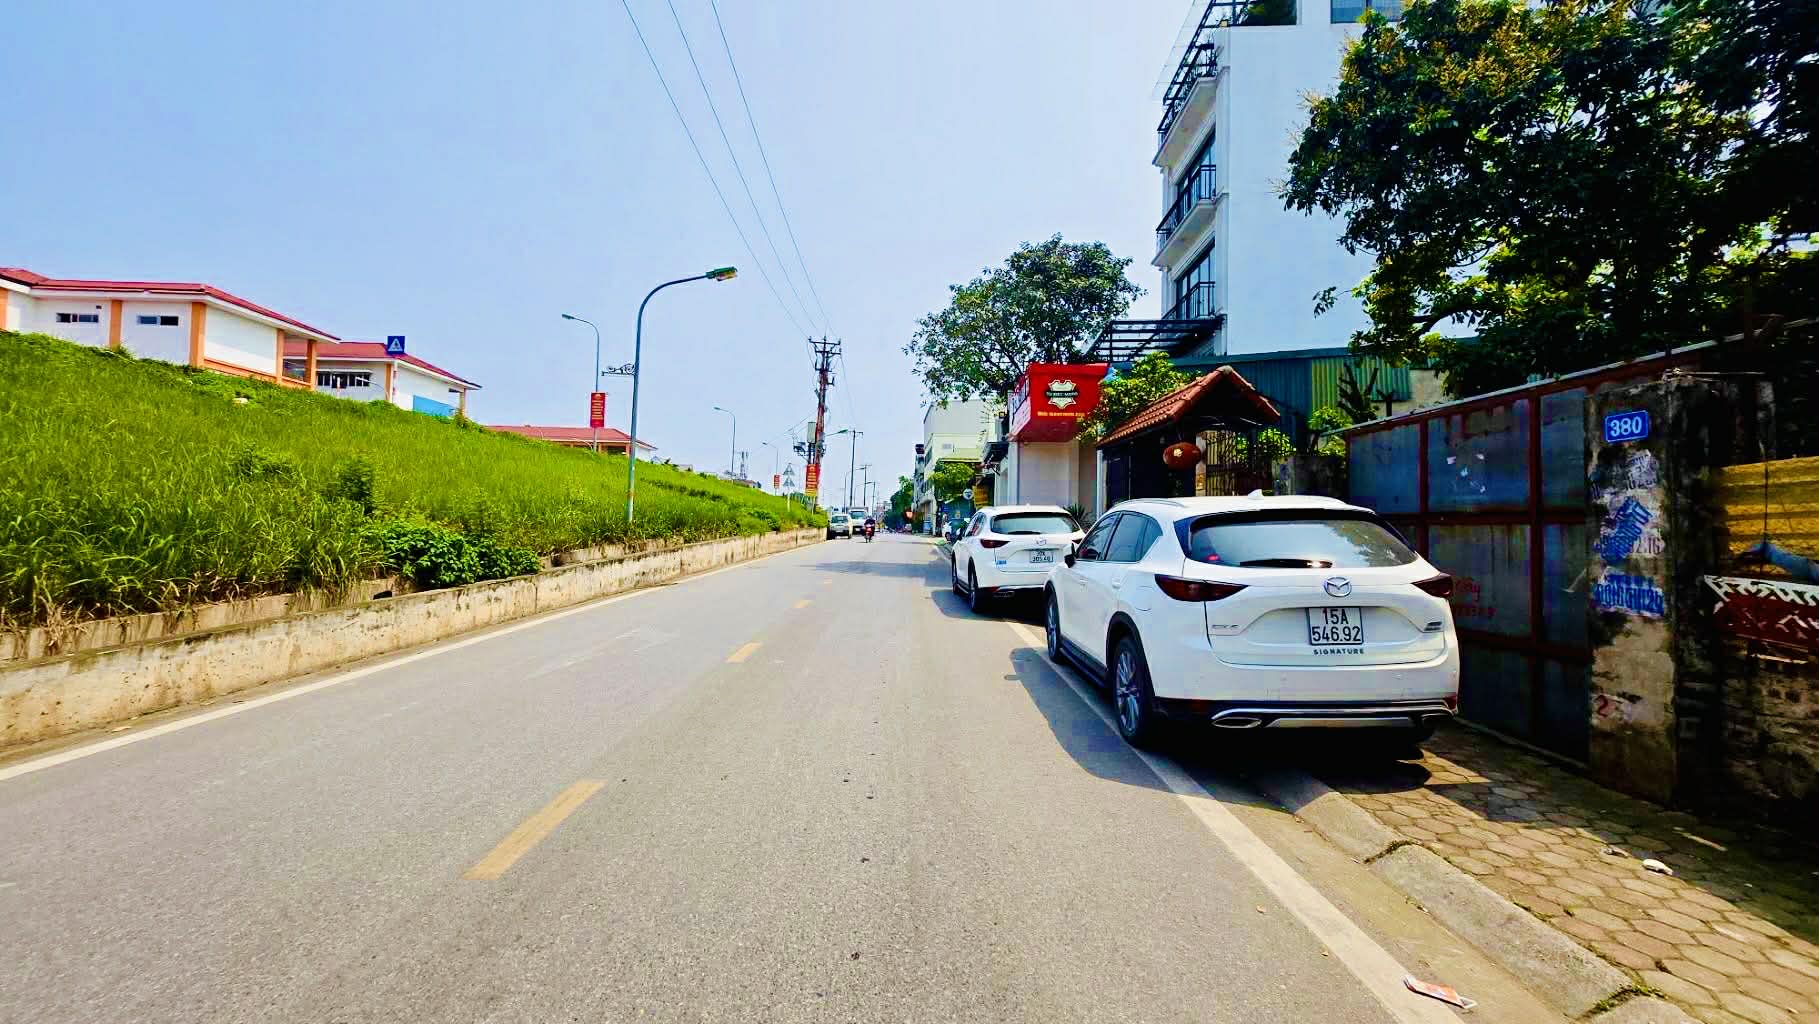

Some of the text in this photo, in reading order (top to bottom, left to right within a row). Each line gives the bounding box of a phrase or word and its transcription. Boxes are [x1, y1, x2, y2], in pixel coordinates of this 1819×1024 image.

[1610, 416, 1642, 437] 380
[1322, 608, 1349, 625] 15A
[1312, 626, 1361, 642] 546.92
